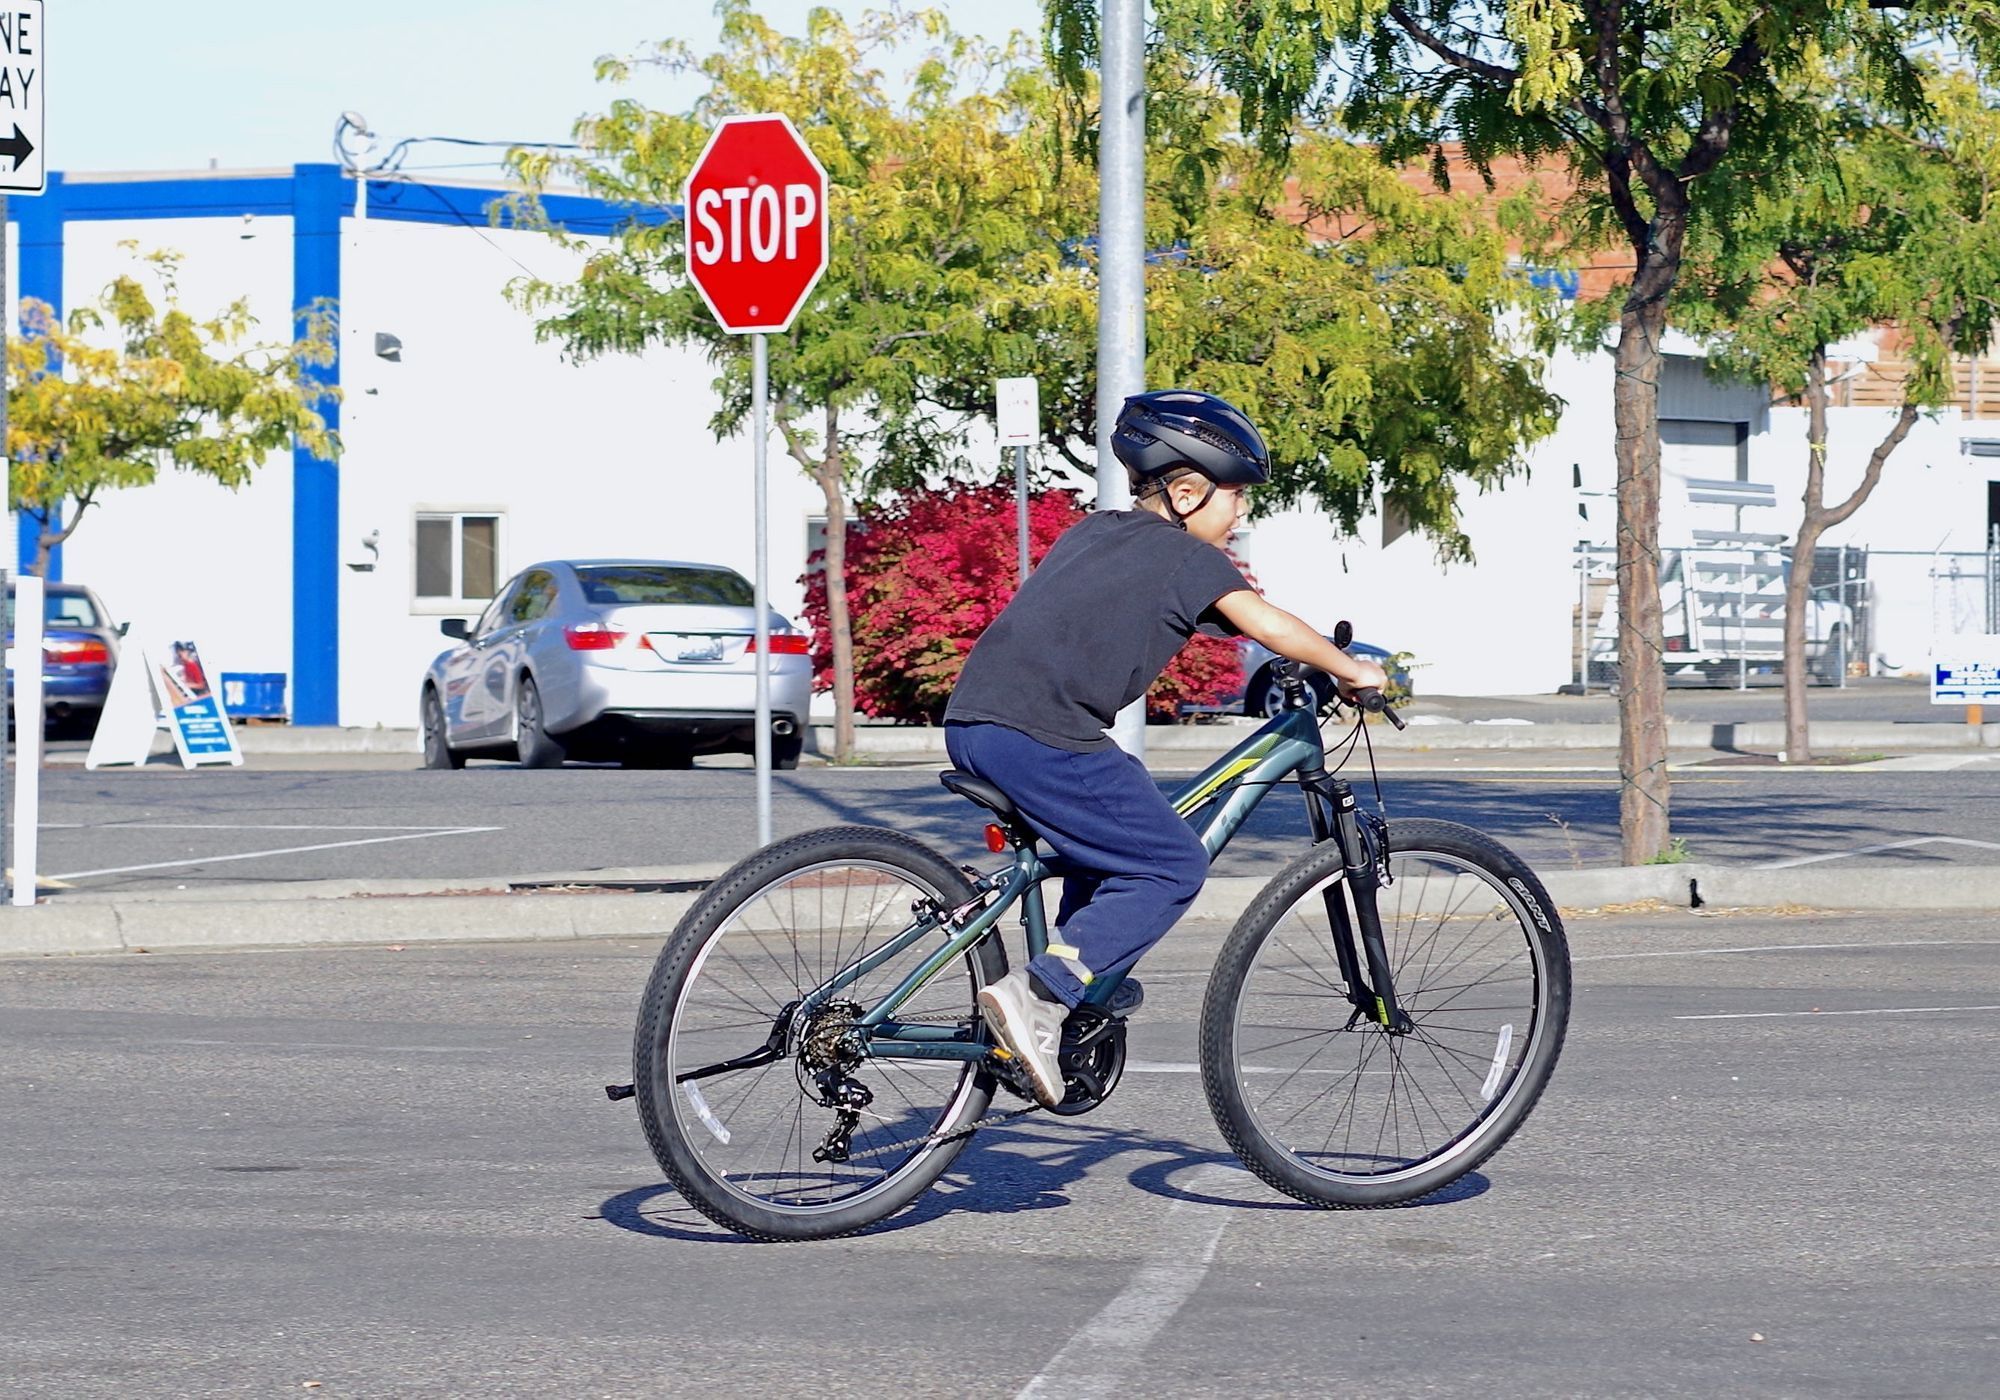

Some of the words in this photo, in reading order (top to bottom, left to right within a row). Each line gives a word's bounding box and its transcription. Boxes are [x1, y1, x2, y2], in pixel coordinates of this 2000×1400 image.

[0, 12, 32, 55] NE
[0, 66, 35, 110] AY
[695, 183, 816, 265] STOP
[1507, 877, 1552, 933] GIANT
